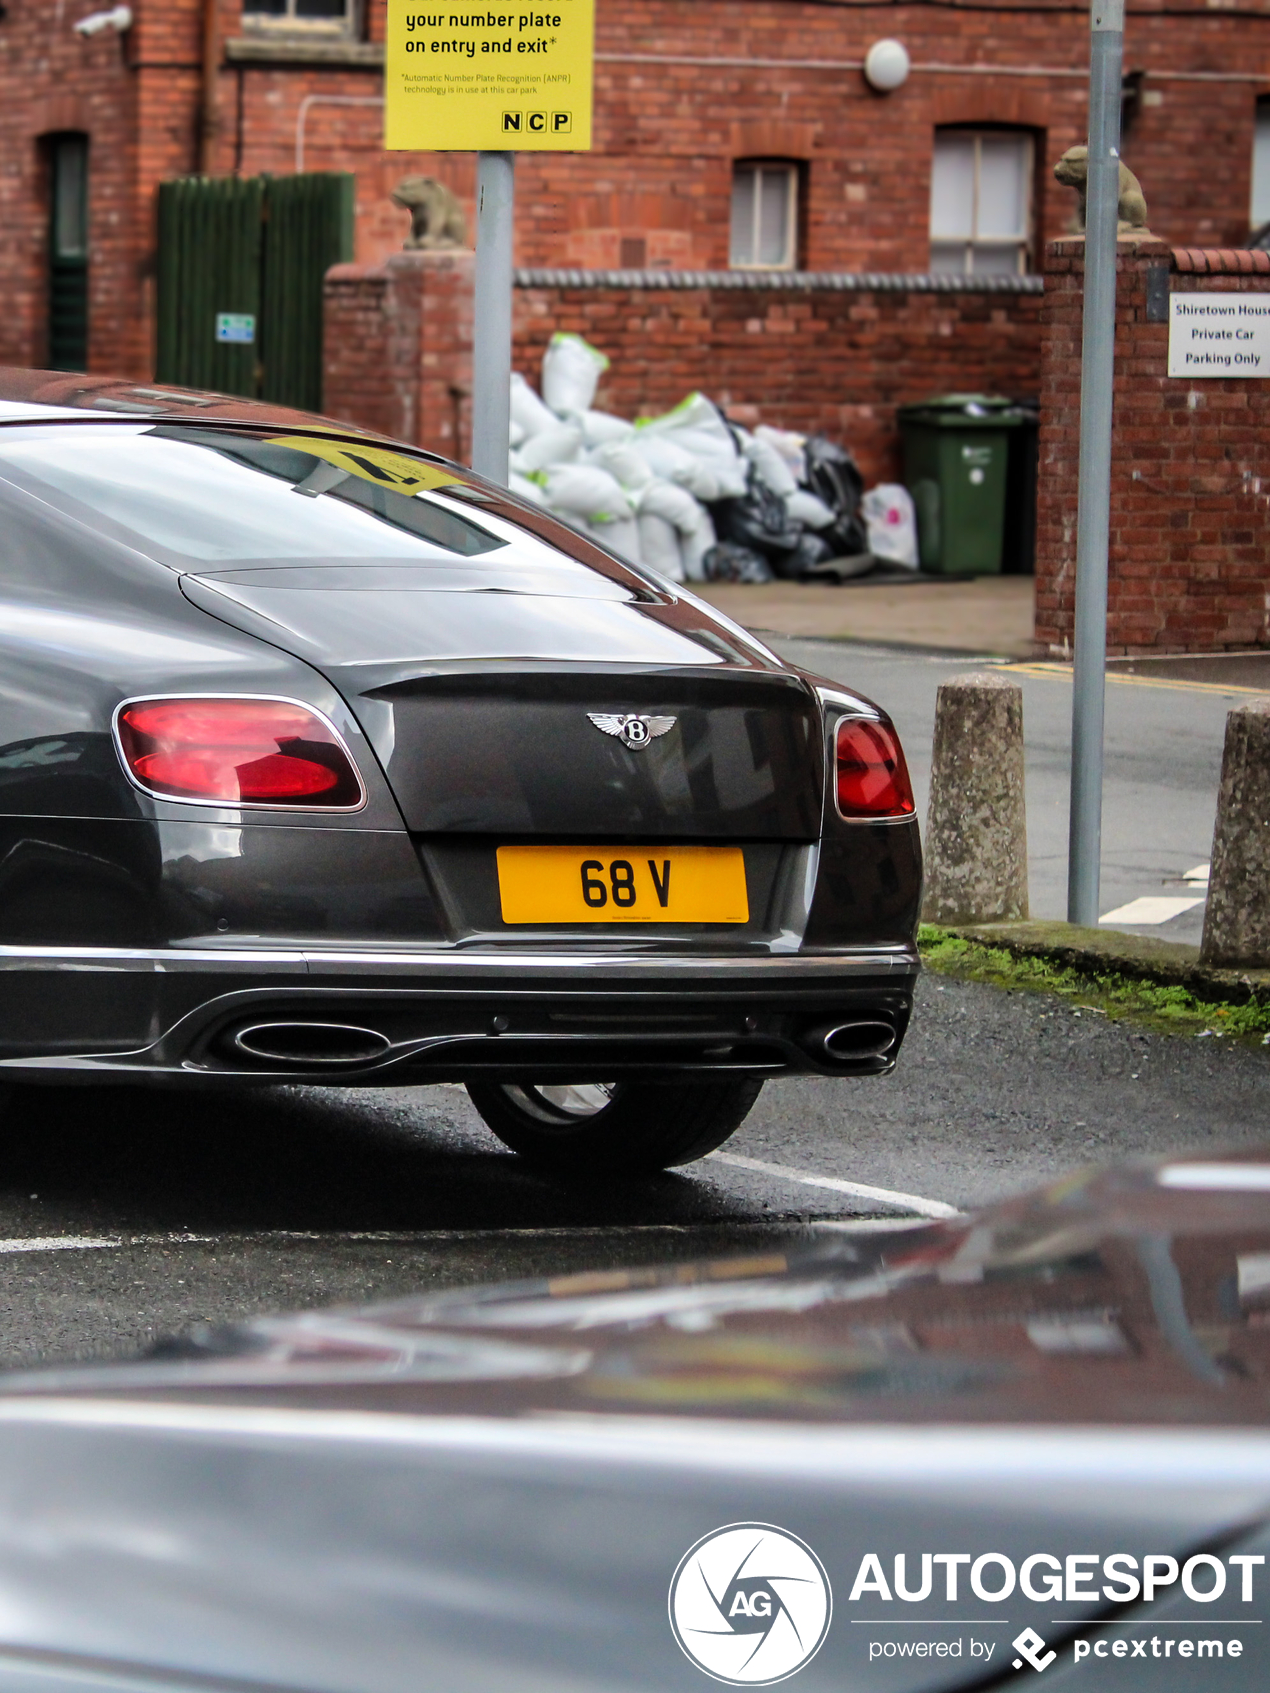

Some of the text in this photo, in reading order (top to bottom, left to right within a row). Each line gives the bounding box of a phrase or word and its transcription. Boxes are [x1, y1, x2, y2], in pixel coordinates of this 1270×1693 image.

[406, 12, 561, 32] your number plate
[405, 40, 425, 53] on
[430, 39, 475, 58] entry
[481, 38, 512, 53] and
[444, 74, 474, 82] Number
[476, 74, 495, 82] Plate
[497, 74, 541, 84] Recognition
[404, 86, 446, 95] technology
[448, 86, 455, 94] is
[456, 86, 463, 94] in
[480, 86, 488, 94] at
[490, 86, 505, 94] this
[520, 86, 537, 95] park
[1176, 304, 1270, 316] Shiretown Hous
[1191, 328, 1255, 340] Private Car
[1186, 352, 1261, 367] Parking Only
[580, 859, 671, 908] 68 V
